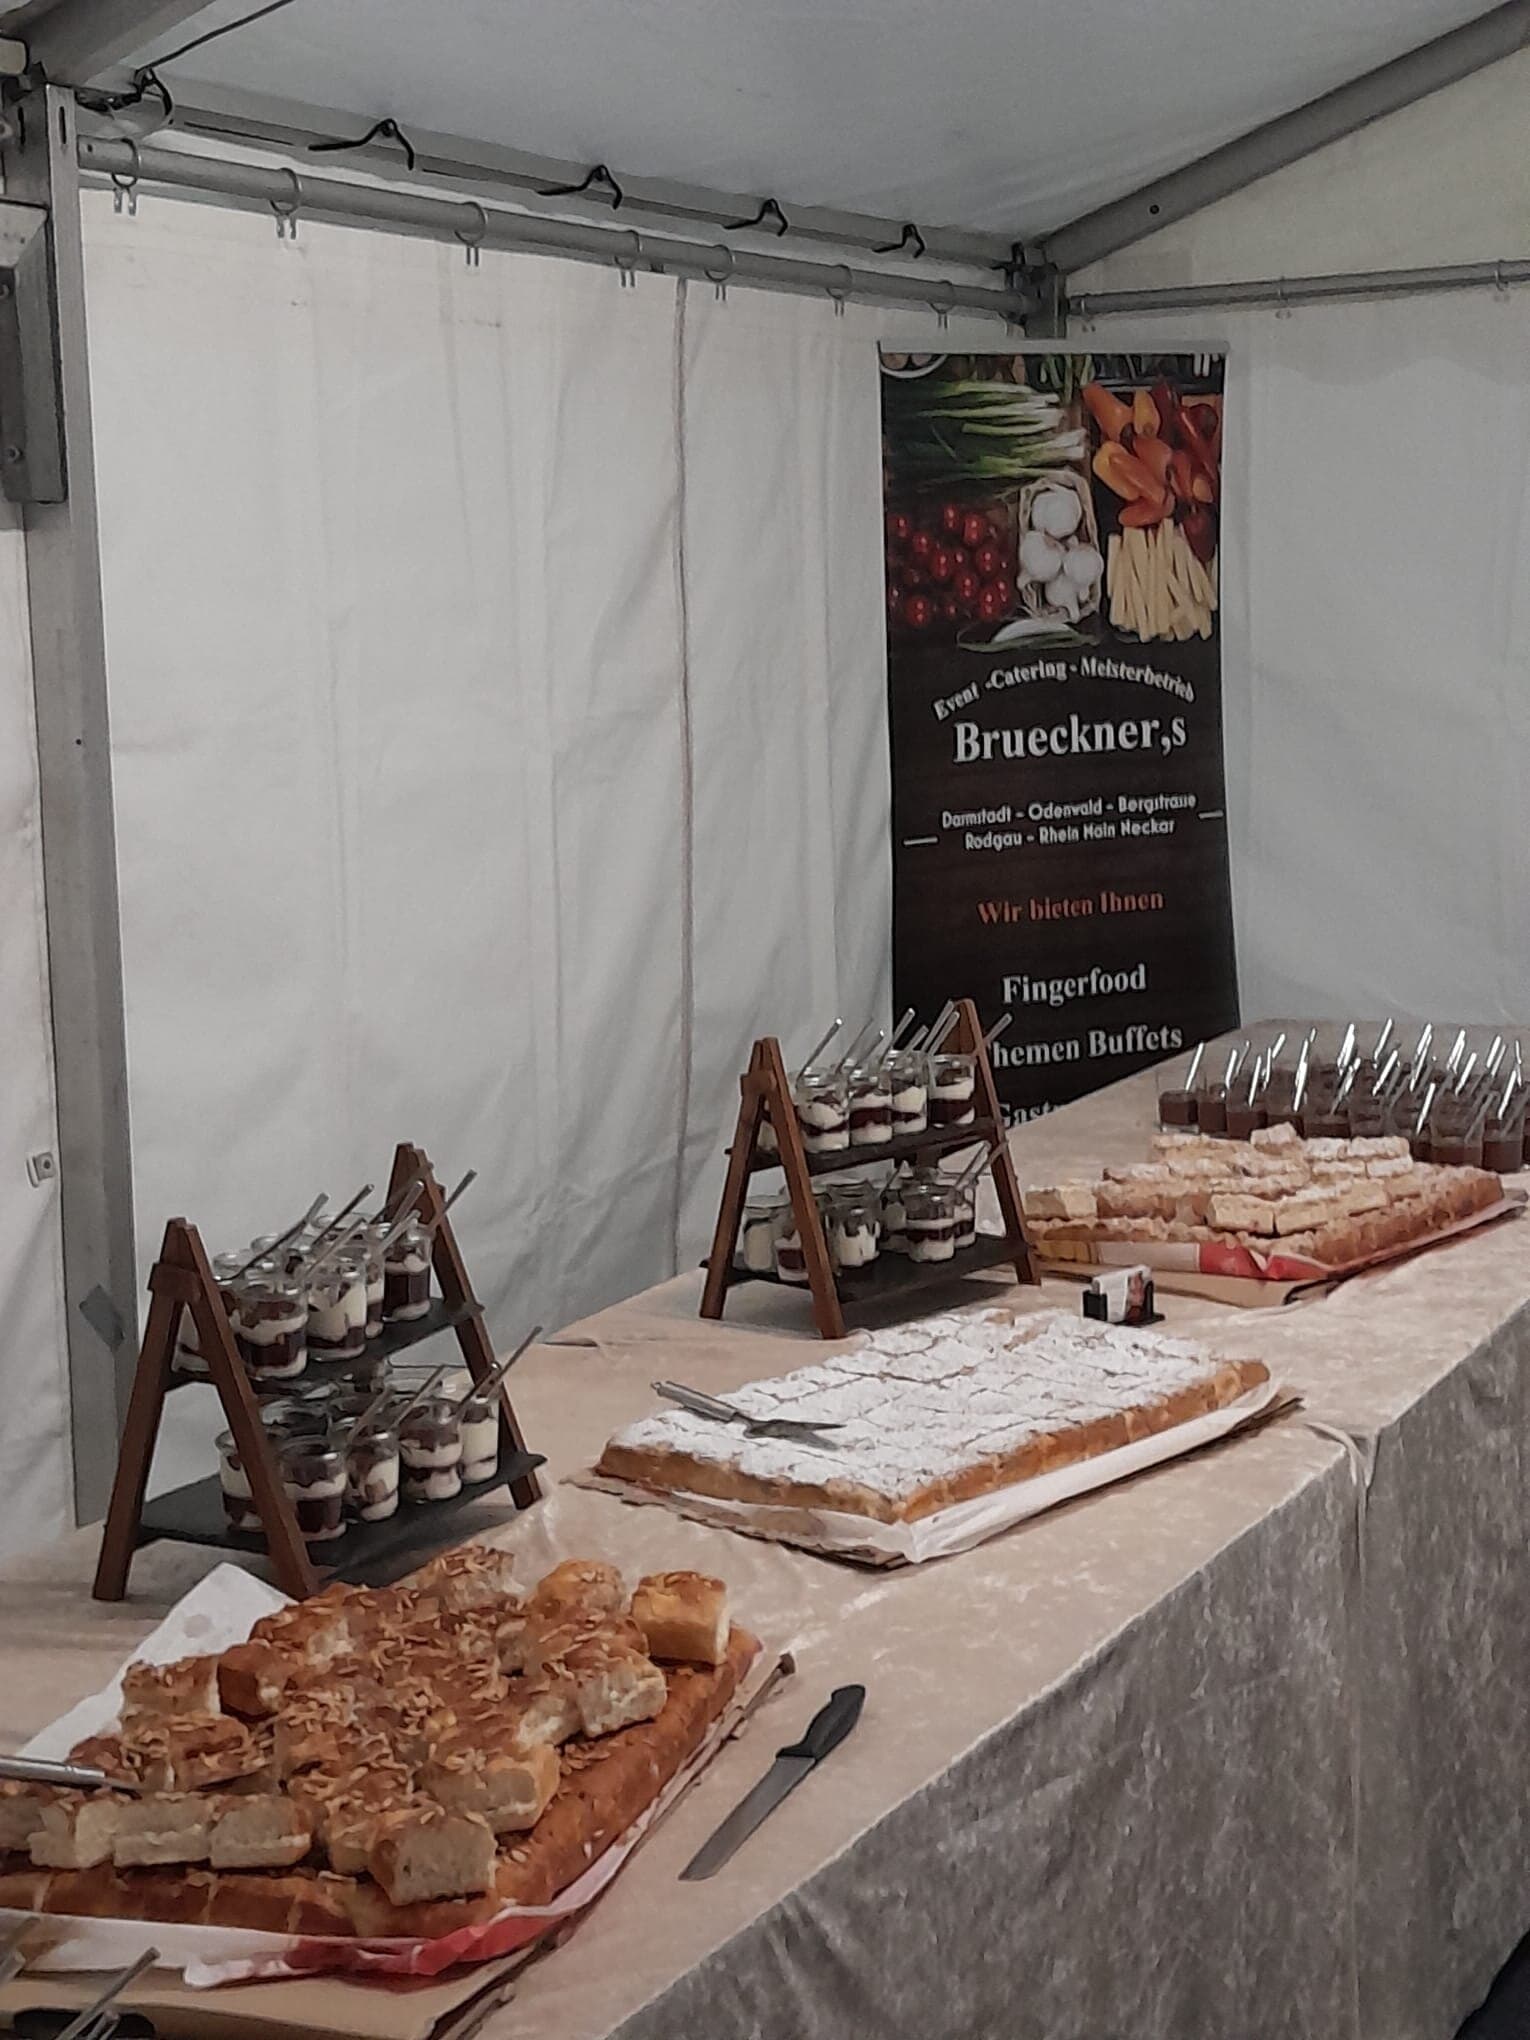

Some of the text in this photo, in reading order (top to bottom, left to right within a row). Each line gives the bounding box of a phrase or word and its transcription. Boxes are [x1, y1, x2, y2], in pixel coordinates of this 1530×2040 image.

[933, 681, 980, 721] Event
[1080, 656, 1195, 703] Meisterbetrieb
[942, 805, 1012, 829] Darmstadt
[1027, 798, 1103, 822] Odenwald
[965, 830, 1023, 851] Rodgau
[1039, 825, 1080, 846] Rhein
[1083, 822, 1116, 840] Main
[1120, 818, 1176, 837] Neckar
[977, 891, 1165, 925] Wir bieten Ihnen
[1003, 964, 1147, 1007] Fingerfood
[988, 1025, 1184, 1069] hemen Buffets
